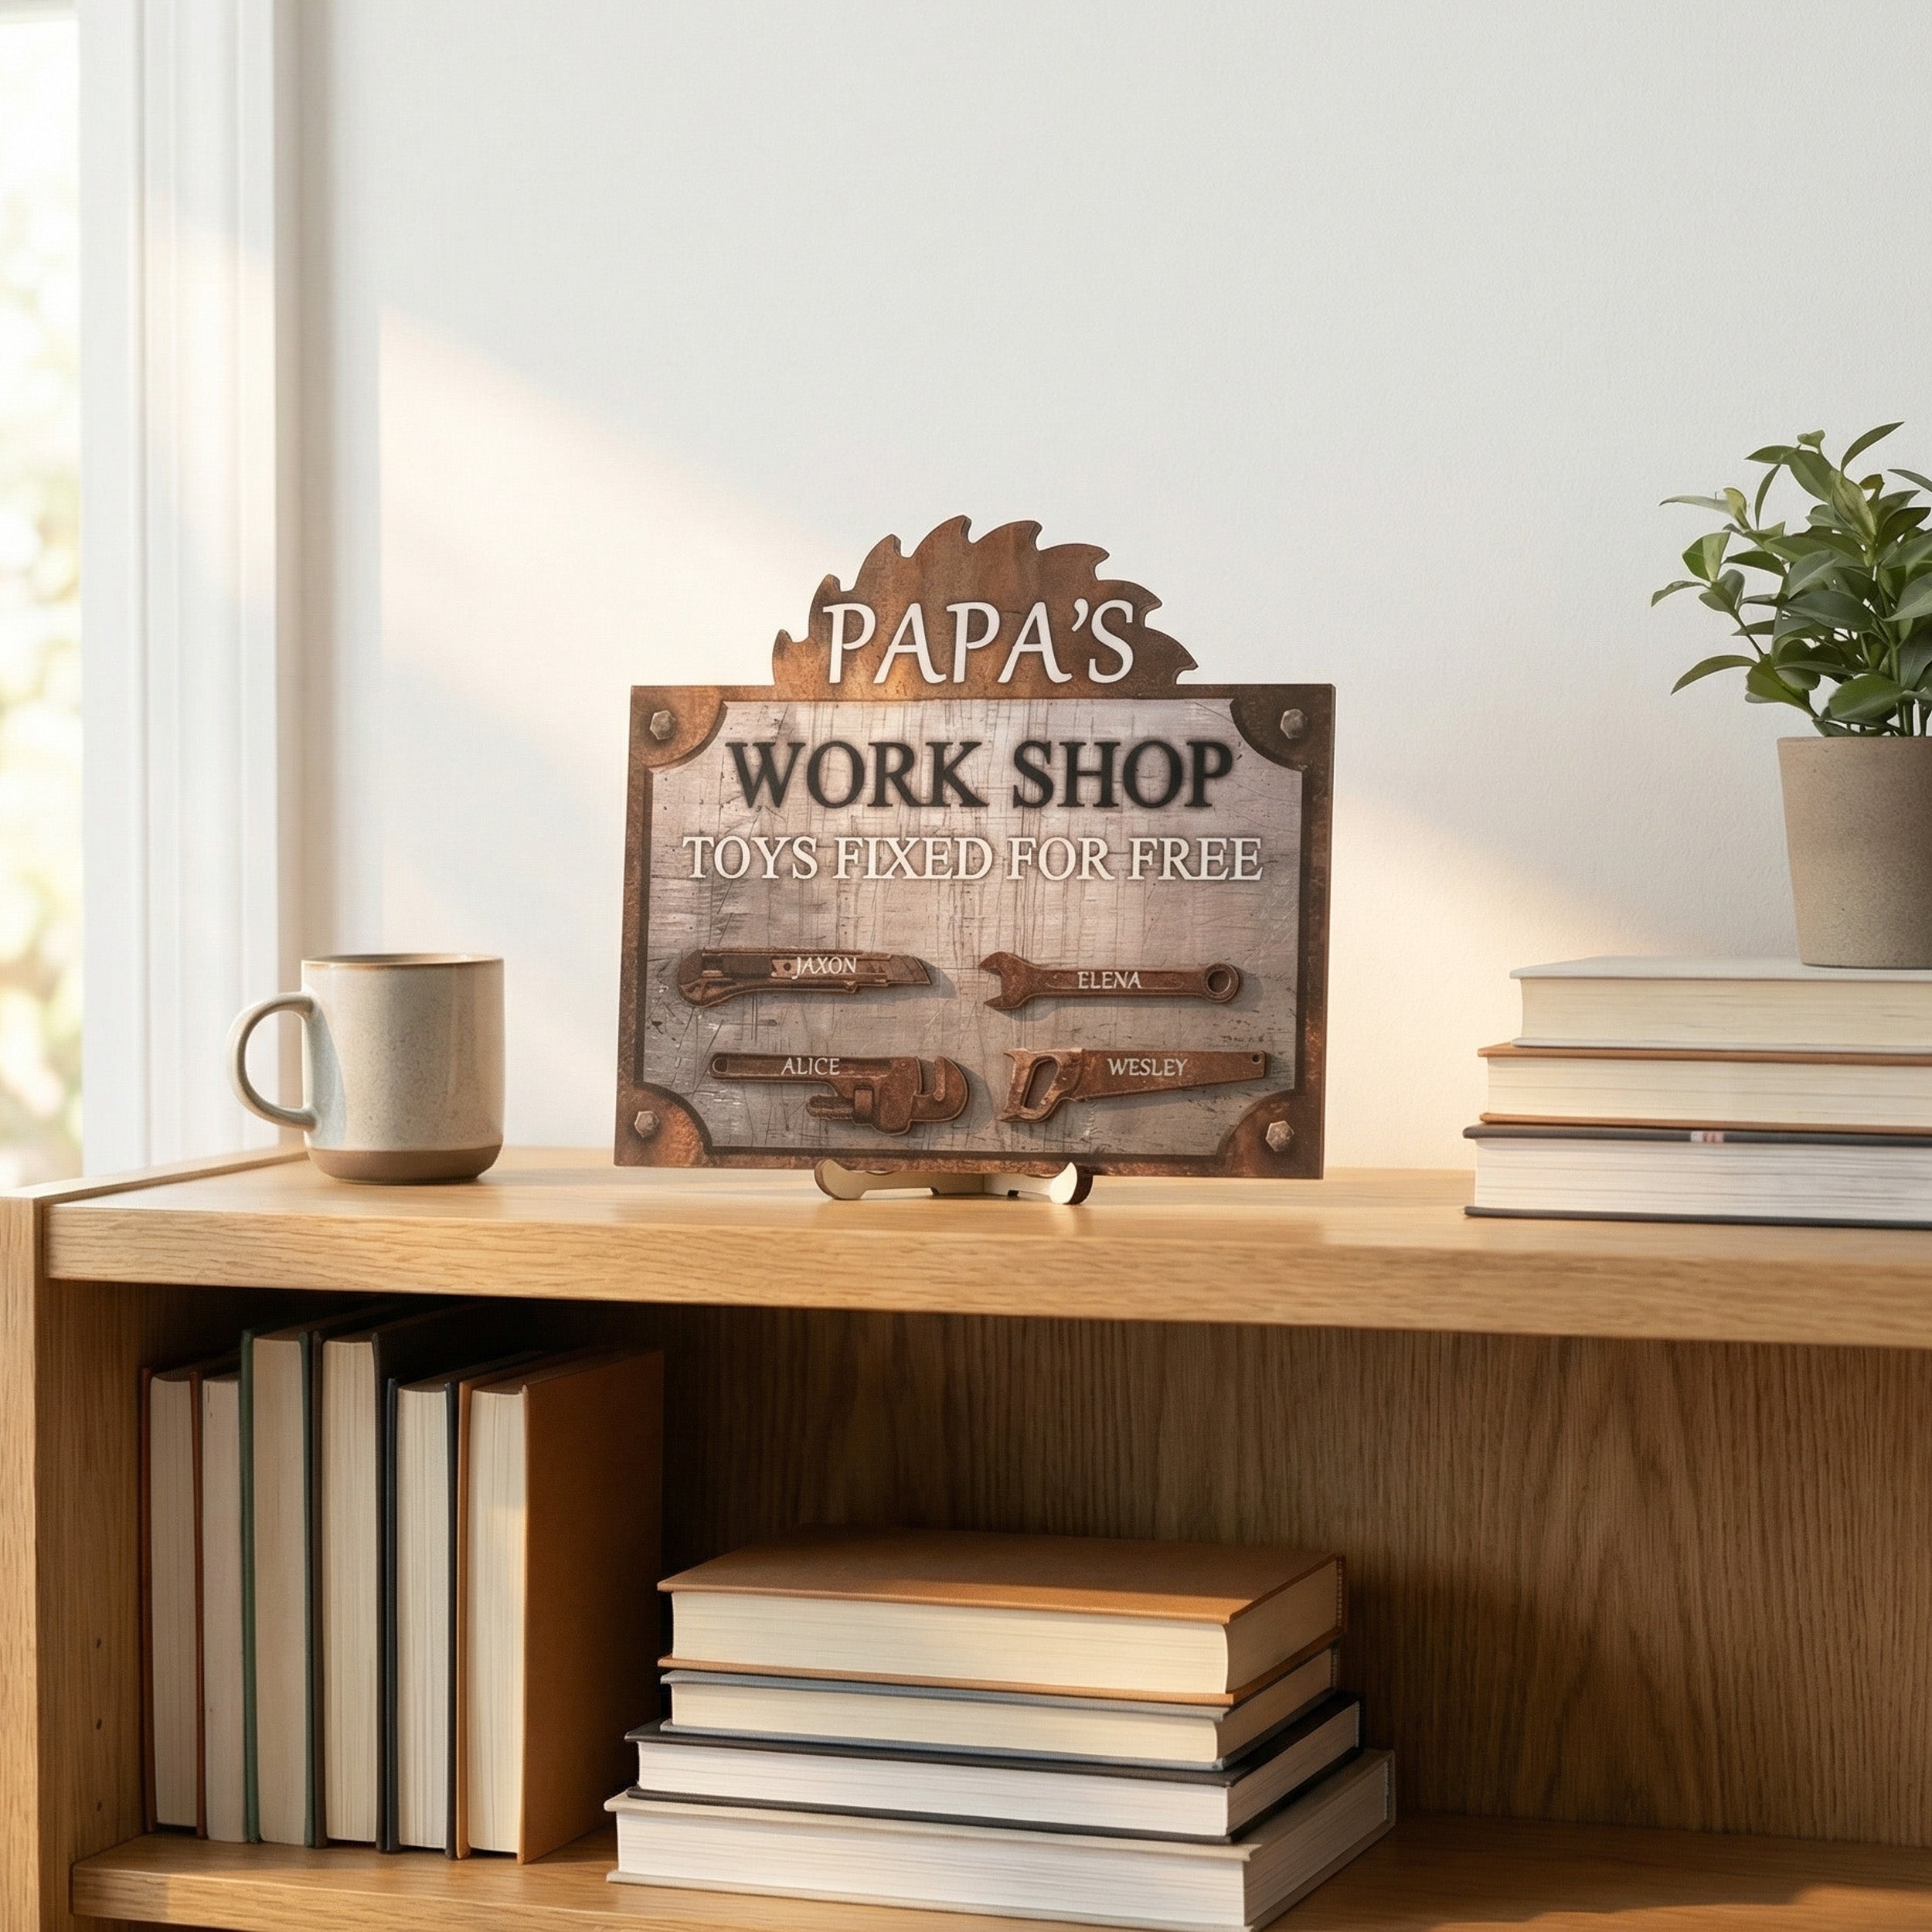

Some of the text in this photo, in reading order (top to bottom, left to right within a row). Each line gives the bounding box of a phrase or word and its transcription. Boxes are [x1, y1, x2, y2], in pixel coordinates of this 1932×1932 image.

[821, 597, 1135, 685] PAPA'S
[725, 740, 1233, 809] WORK SHOP
[682, 835, 1264, 881] TOYS FIXED FOR FREE
[794, 956, 857, 979] JAXON
[1077, 971, 1143, 990] ELENA
[781, 1056, 840, 1077] ALICE
[1107, 1057, 1188, 1078] WESLEY
